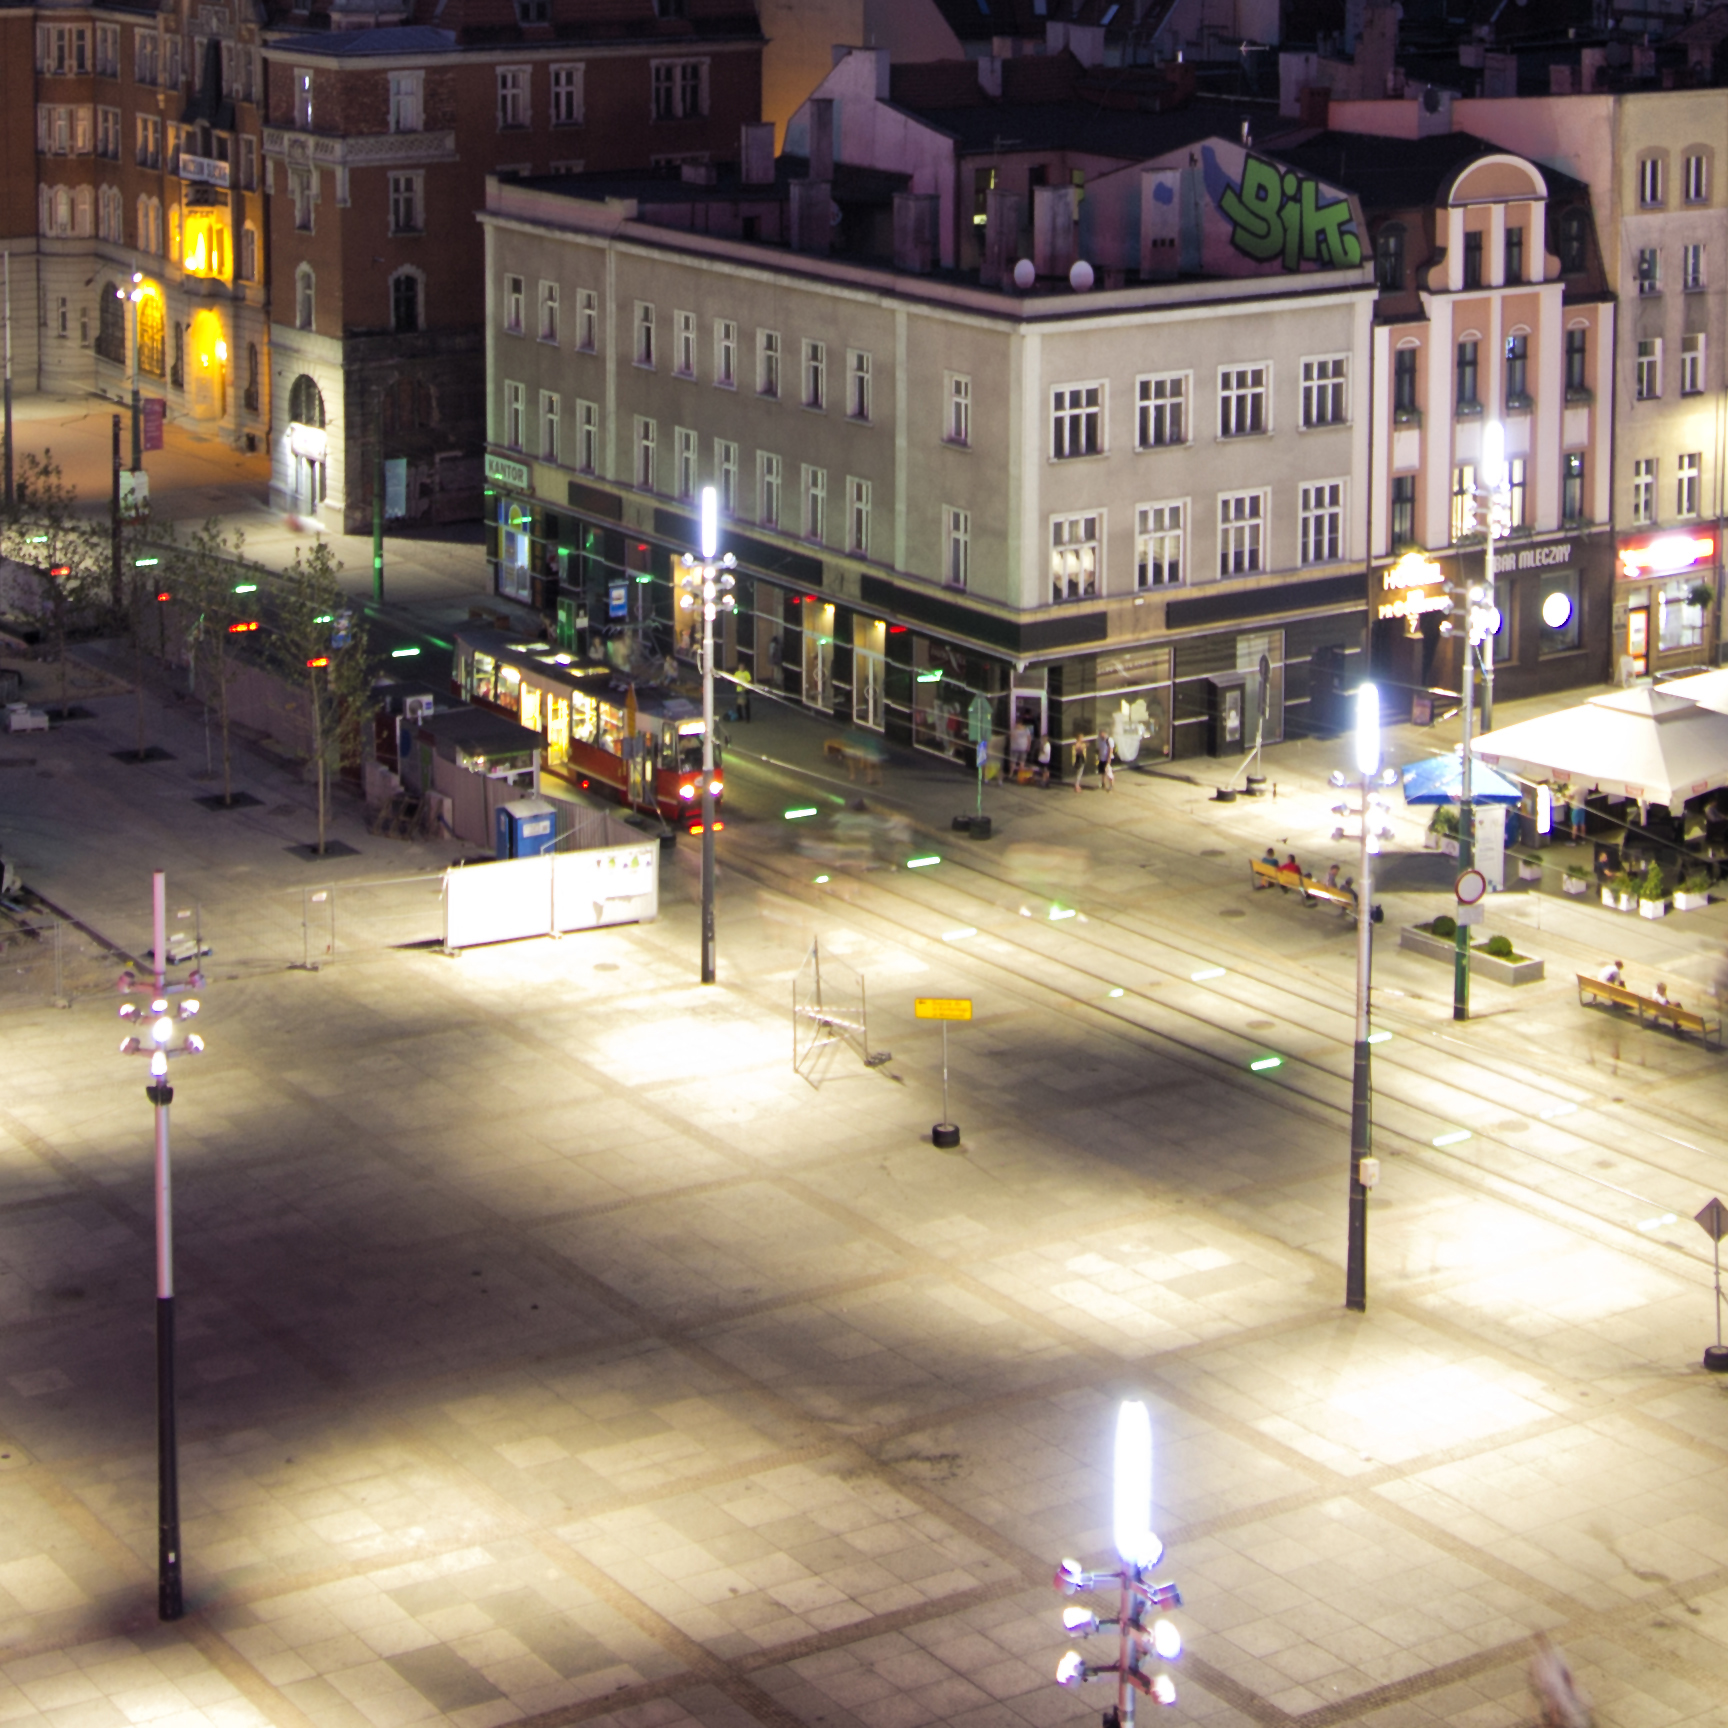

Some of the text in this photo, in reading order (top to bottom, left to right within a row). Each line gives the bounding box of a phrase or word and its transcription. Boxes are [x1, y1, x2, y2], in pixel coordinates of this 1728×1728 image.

[488, 458, 524, 484] KANTOR
[1493, 543, 1572, 573] BAR MLECZNY
